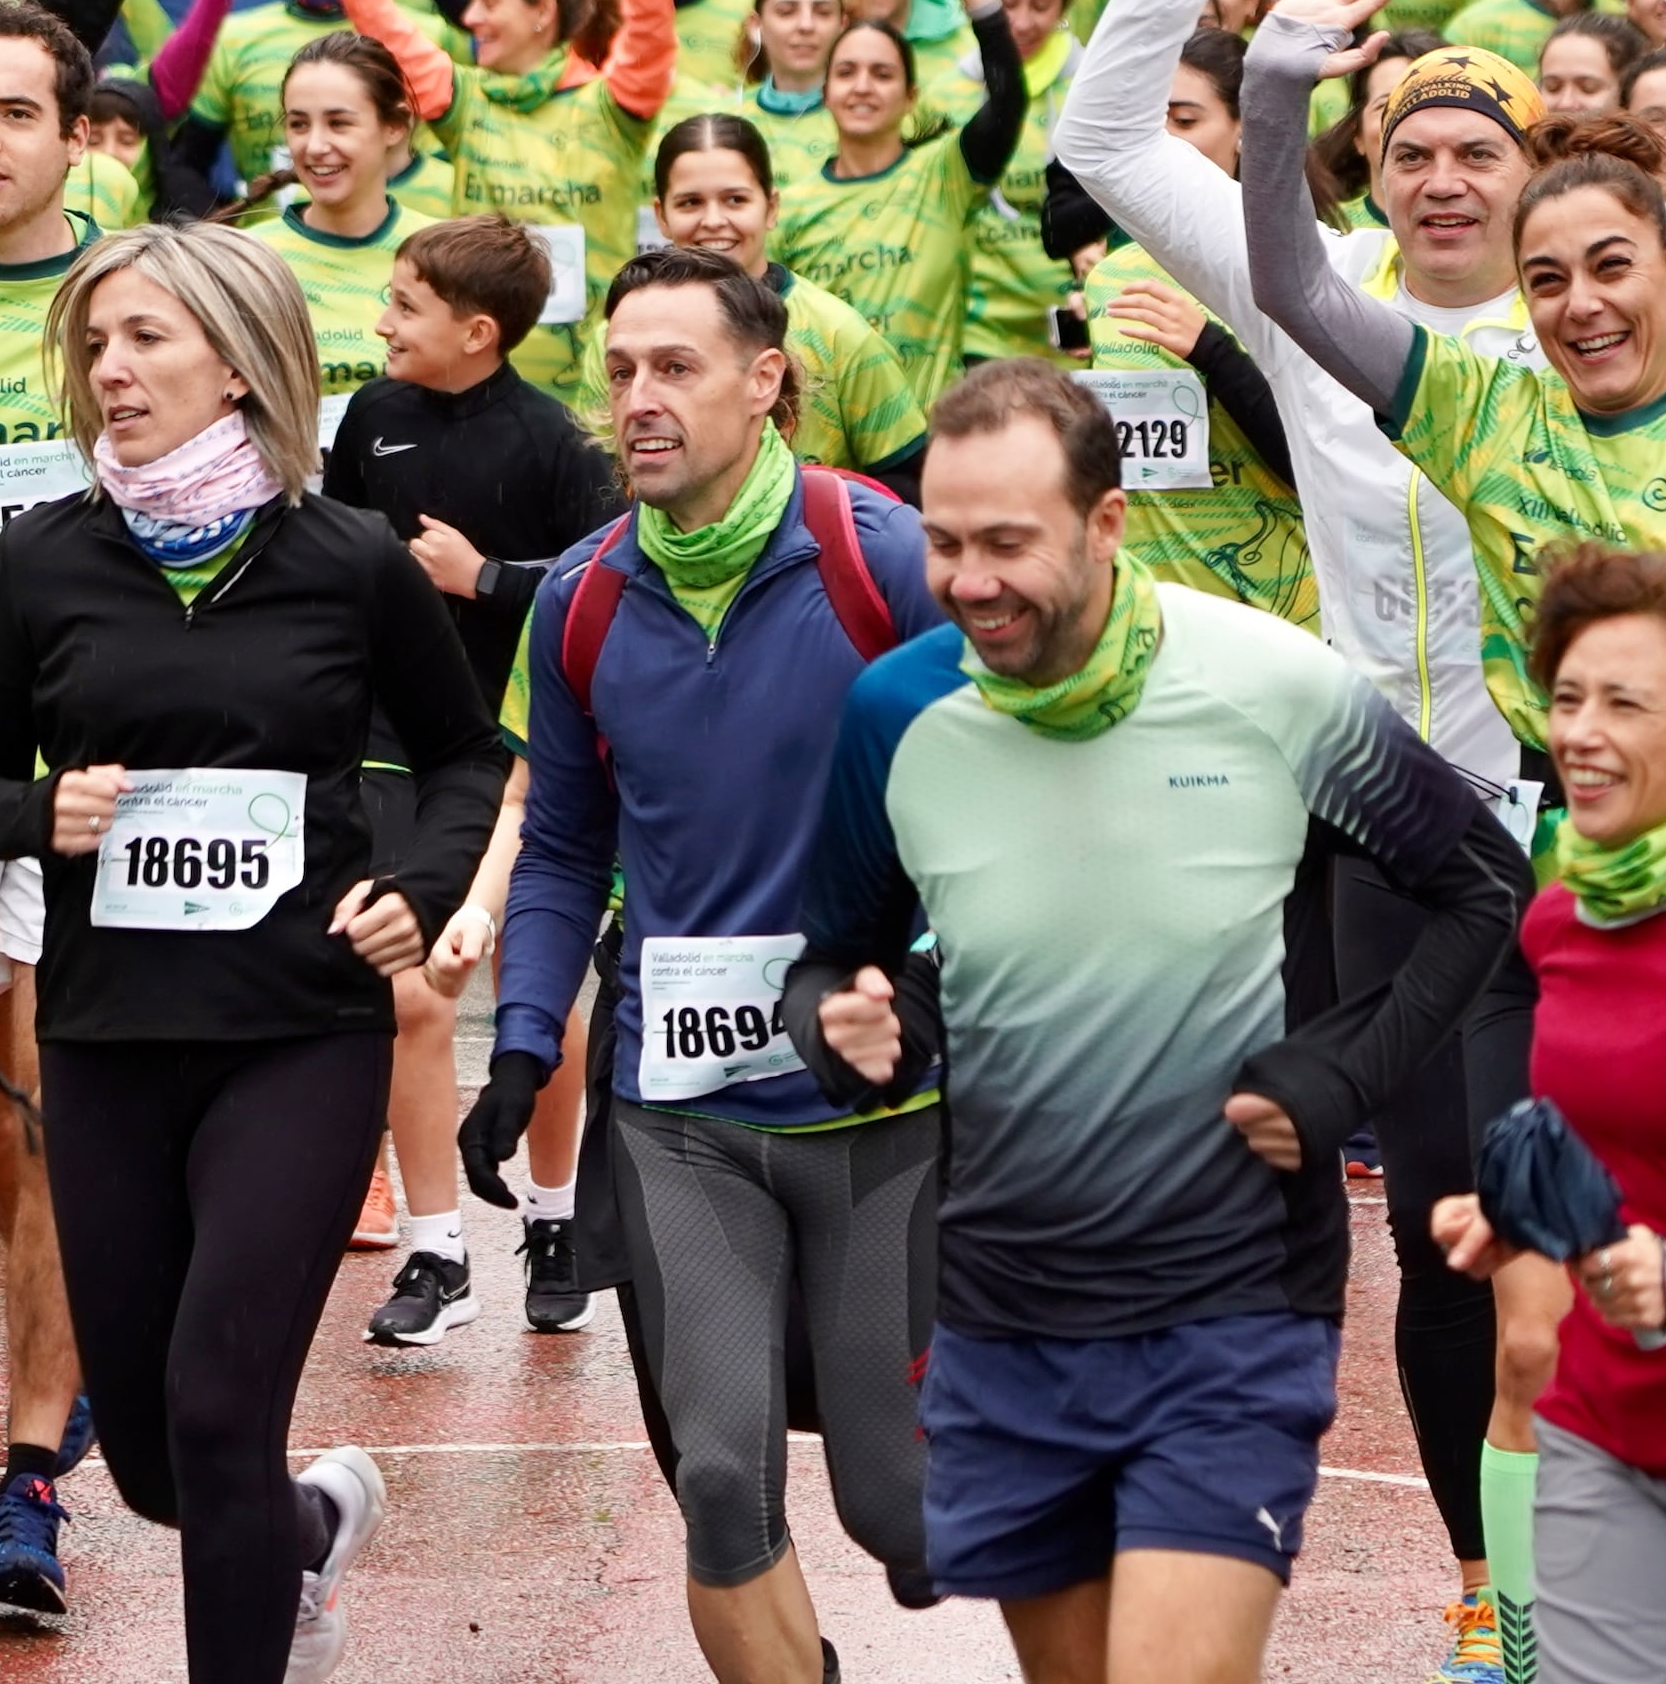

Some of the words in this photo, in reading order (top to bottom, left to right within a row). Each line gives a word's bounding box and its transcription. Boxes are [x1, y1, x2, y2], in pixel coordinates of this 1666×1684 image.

[487, 180, 602, 206] marcha
[7, 466, 48, 478] cáncer
[1169, 775, 1229, 788] KUIKMA
[124, 836, 270, 890] 18695
[651, 952, 701, 964] Valladolid
[651, 967, 680, 977] contra
[683, 966, 692, 977] el
[695, 965, 727, 977] cáncer
